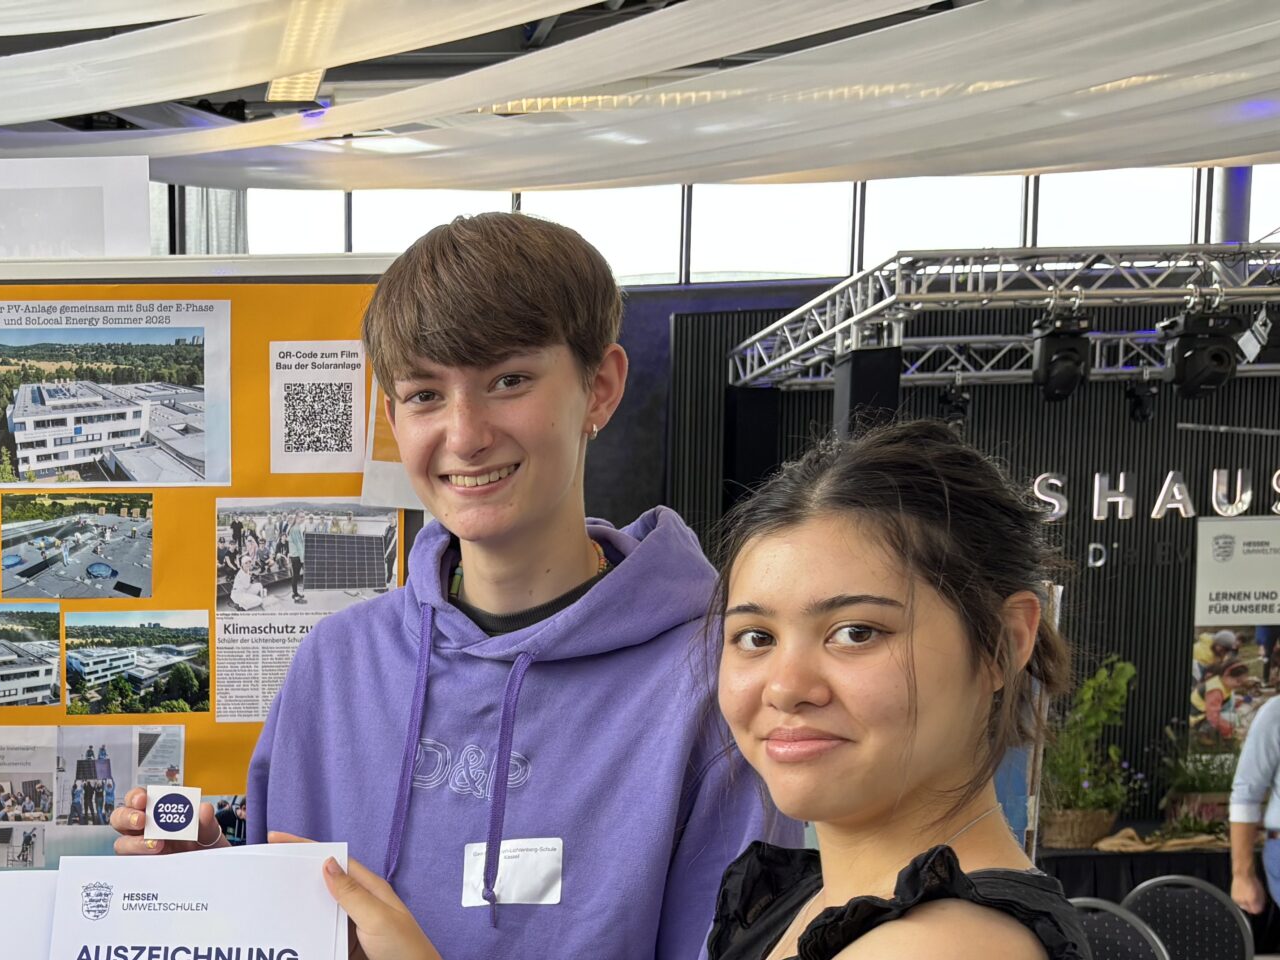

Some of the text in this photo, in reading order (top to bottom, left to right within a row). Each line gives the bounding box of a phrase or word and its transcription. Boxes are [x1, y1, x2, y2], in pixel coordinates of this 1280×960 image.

[6, 304, 58, 315] PV-Anlage
[59, 304, 115, 315] gemeinsam
[117, 304, 134, 313] mit
[135, 304, 155, 313] SuS
[156, 303, 174, 313] der
[175, 303, 214, 313] E-Phase
[3, 315, 171, 327] und SoLocal Energy Sommer 2025
[278, 351, 318, 359] QR-Code
[340, 350, 359, 359] Film
[275, 361, 362, 371] Bau der Solaranlage
[1033, 468, 1280, 523] SHAU
[1209, 591, 1278, 602] LERNEN UND
[1208, 602, 1275, 615] FÜR UNSERE
[223, 622, 296, 635] Klimaschutz
[157, 803, 190, 813] 2025/
[159, 814, 186, 823] 2026
[122, 892, 159, 901] HESSEN
[121, 902, 209, 912] UMWELTSCHULEN
